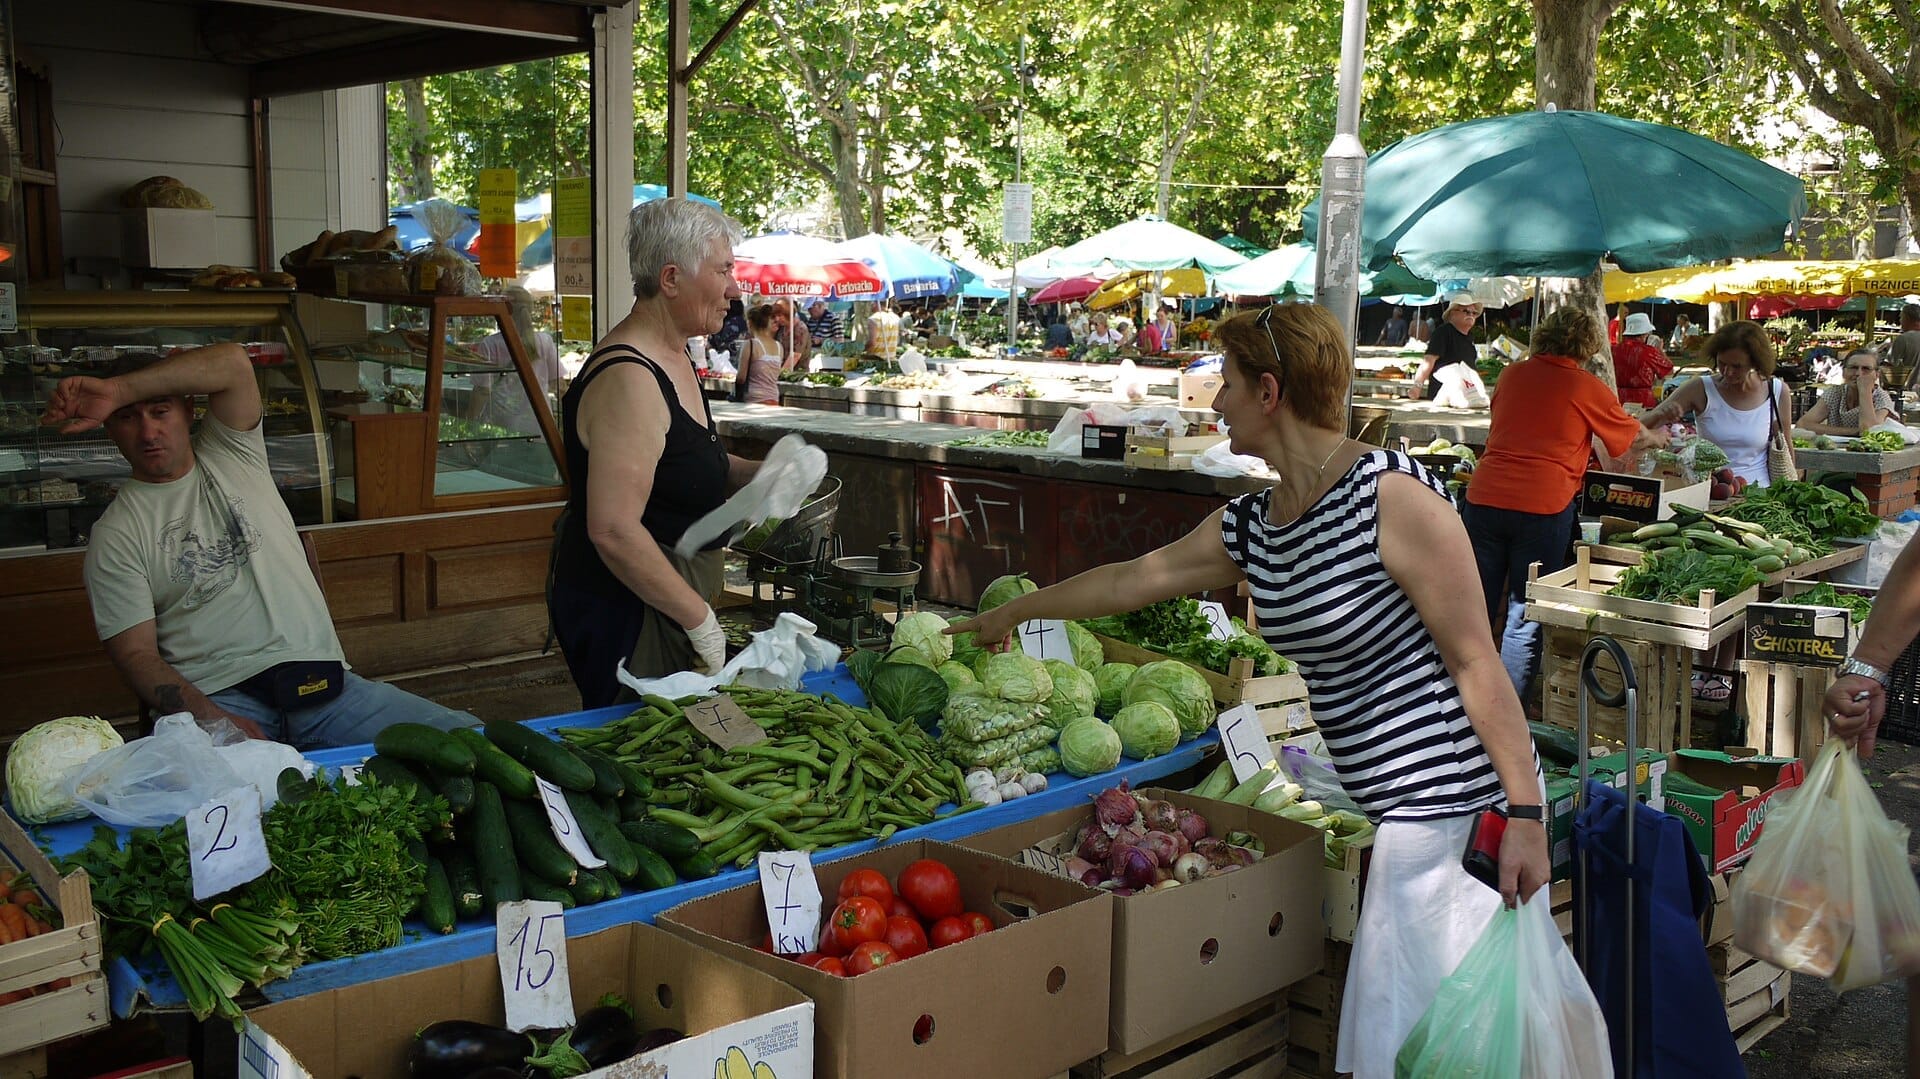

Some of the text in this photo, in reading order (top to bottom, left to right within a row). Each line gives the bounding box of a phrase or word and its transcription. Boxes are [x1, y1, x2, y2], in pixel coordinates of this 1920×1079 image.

[1865, 279, 1919, 290] TRŽNICE
[1025, 619, 1054, 659] 4
[697, 703, 732, 734] 7
[1226, 717, 1262, 771] 5
[202, 805, 238, 861] 2
[541, 782, 571, 835] 5
[771, 862, 802, 926] 7
[509, 914, 564, 991] 15
[778, 932, 807, 954] KN
